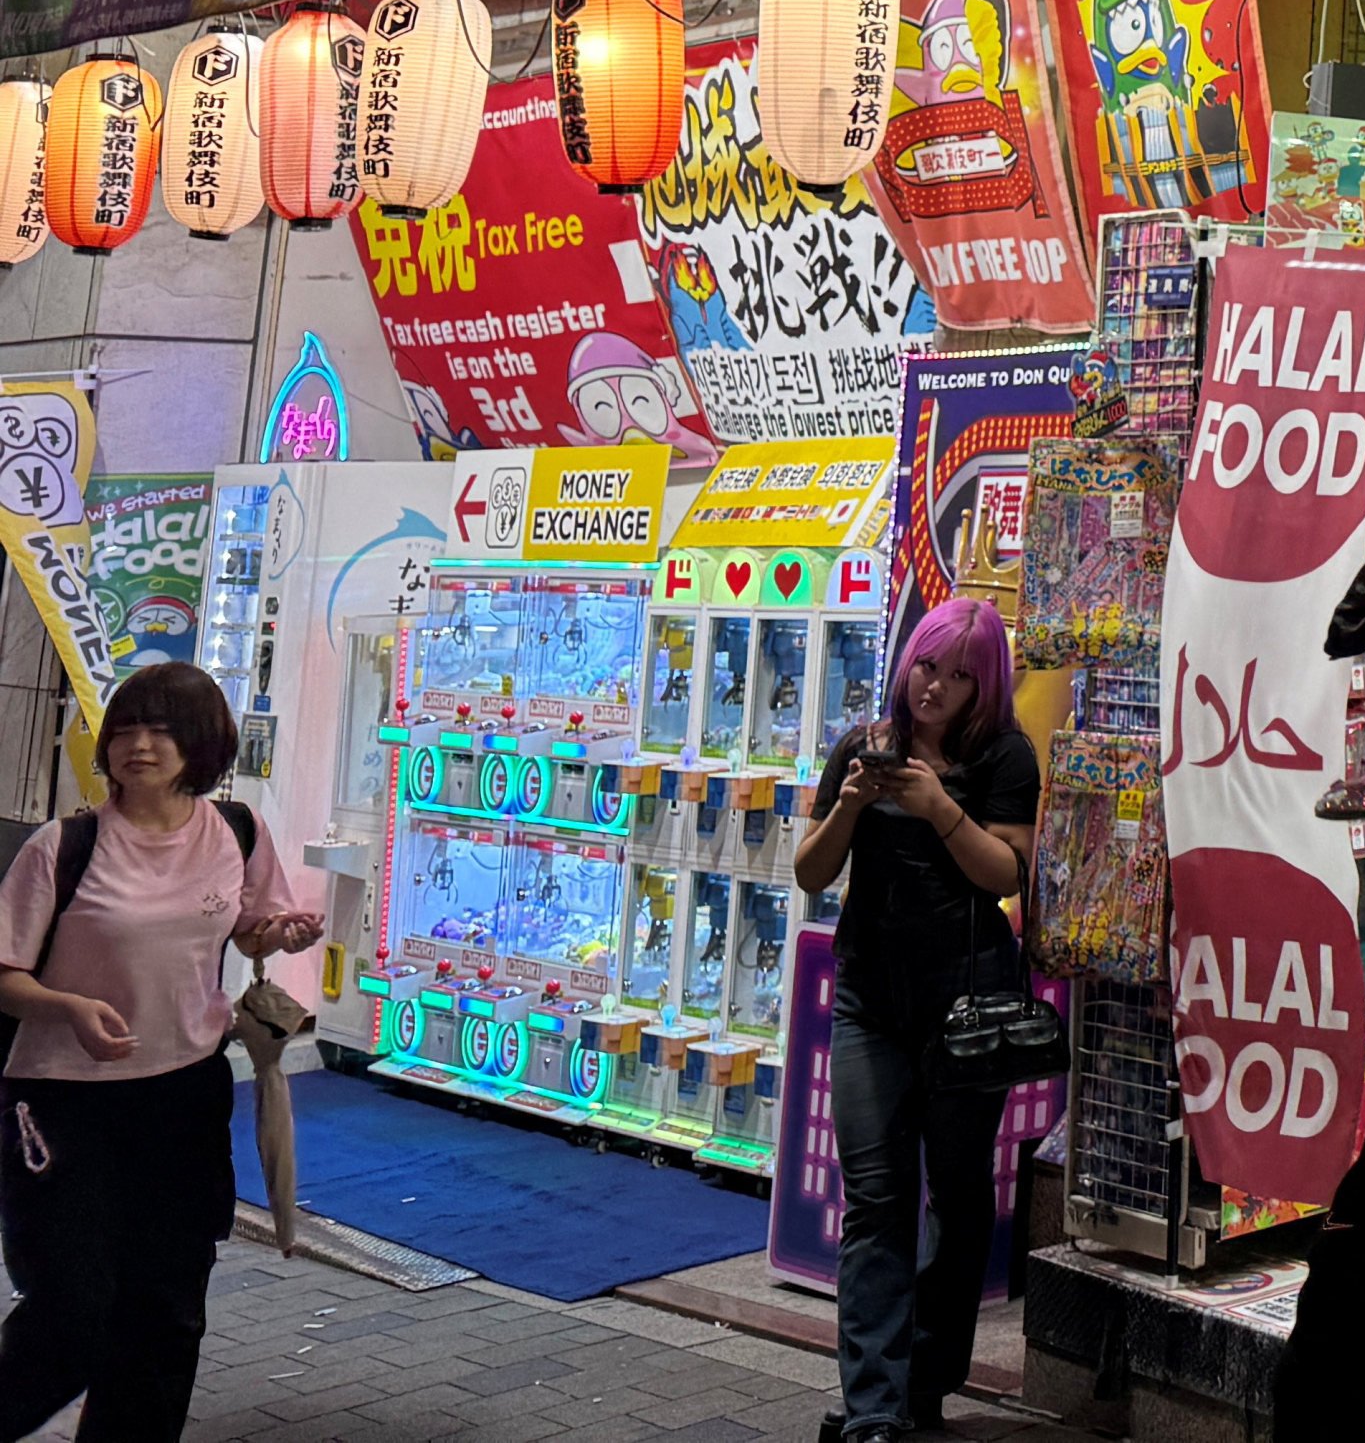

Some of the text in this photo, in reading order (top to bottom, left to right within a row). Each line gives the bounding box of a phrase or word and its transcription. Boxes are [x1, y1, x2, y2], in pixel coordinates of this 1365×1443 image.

[363, 47, 405, 179] 新宿歌舞伎町
[94, 114, 138, 226] 新宿歌舞伎町
[185, 91, 229, 208] 新宿歌舞伎町
[360, 194, 477, 299] 免税
[476, 213, 584, 259] Tax Free
[956, 236, 1018, 285] FREE
[384, 301, 606, 347] Tax free cash register
[446, 347, 537, 381] is on the
[918, 371, 986, 392] WELCOME
[990, 370, 1008, 387] TO
[1012, 366, 1044, 387] DON
[470, 386, 542, 433] 3rd
[705, 402, 895, 442] Challenge the lowest price
[560, 472, 631, 500] MONEY
[533, 509, 649, 543] EXCHANGE
[665, 559, 693, 599] ド
[839, 559, 870, 604] ド
[1175, 1034, 1339, 1138] OOD
